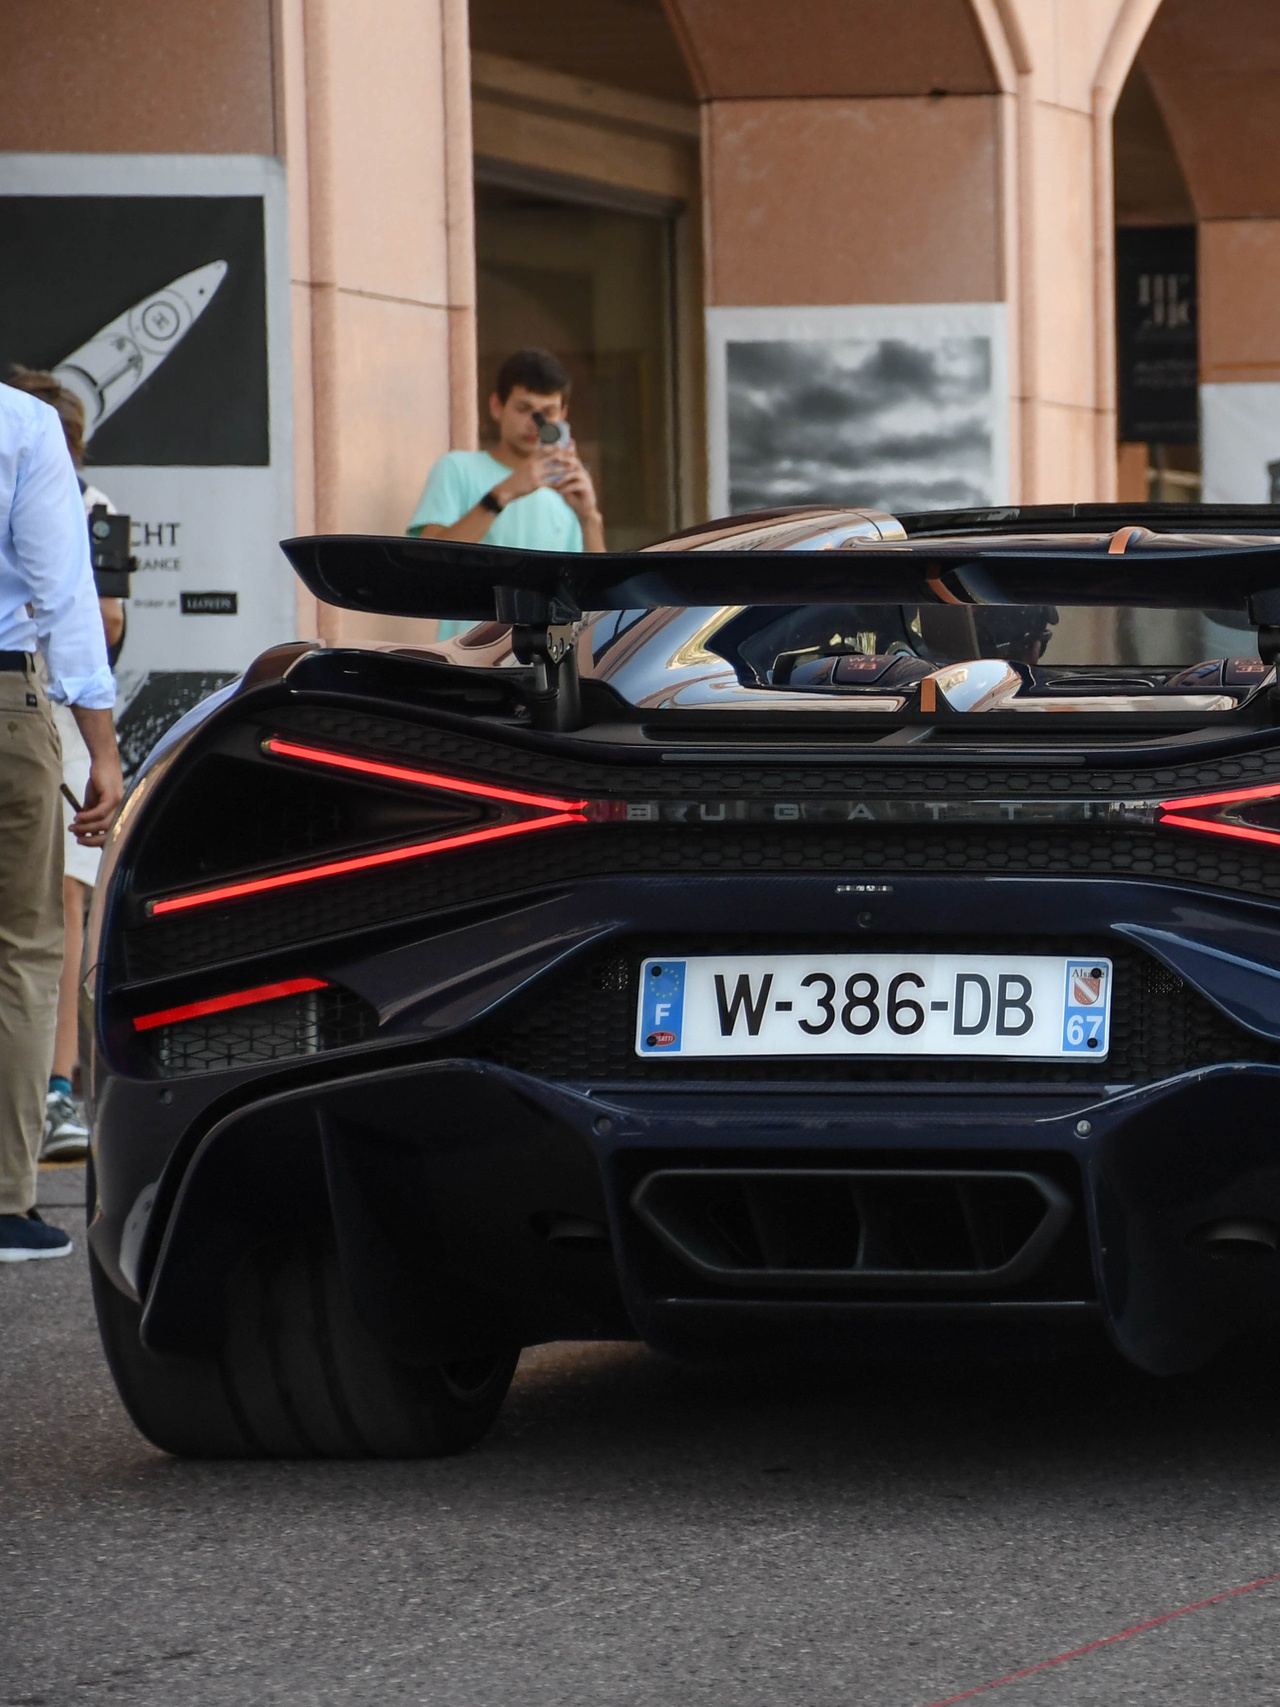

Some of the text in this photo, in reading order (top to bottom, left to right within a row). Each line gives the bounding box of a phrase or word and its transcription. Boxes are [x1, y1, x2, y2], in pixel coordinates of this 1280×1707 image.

[627, 802, 1090, 821] BUGATTI
[655, 1003, 671, 1025] F
[713, 972, 1034, 1037] W-386-DB
[1067, 1015, 1103, 1045] 67
